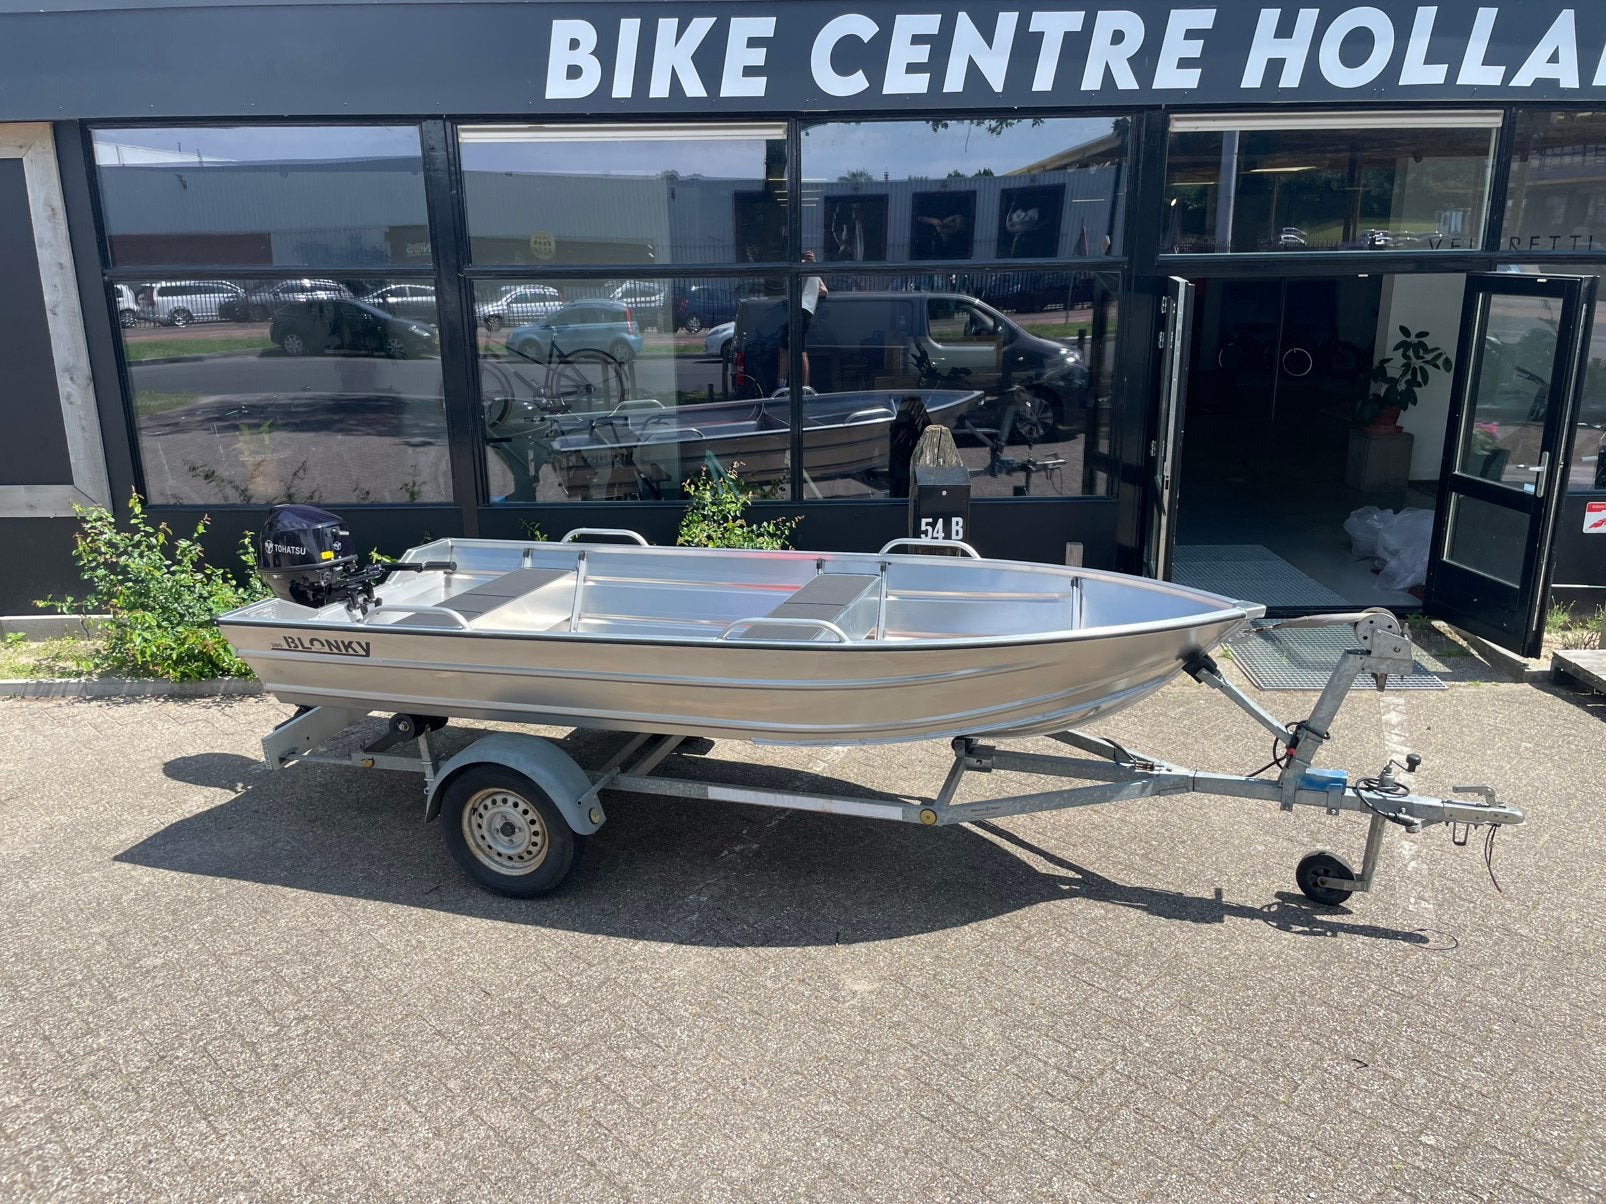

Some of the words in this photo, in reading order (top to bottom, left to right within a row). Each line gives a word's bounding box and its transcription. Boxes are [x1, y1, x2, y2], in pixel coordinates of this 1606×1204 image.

[545, 17, 776, 99] BIKE
[811, 9, 1217, 96] CENTRE
[1240, 6, 1606, 89] HOLLA
[920, 518, 944, 540] 54
[951, 517, 963, 540] B
[274, 544, 306, 555] TOHATSU
[282, 635, 370, 657] BLONKY
